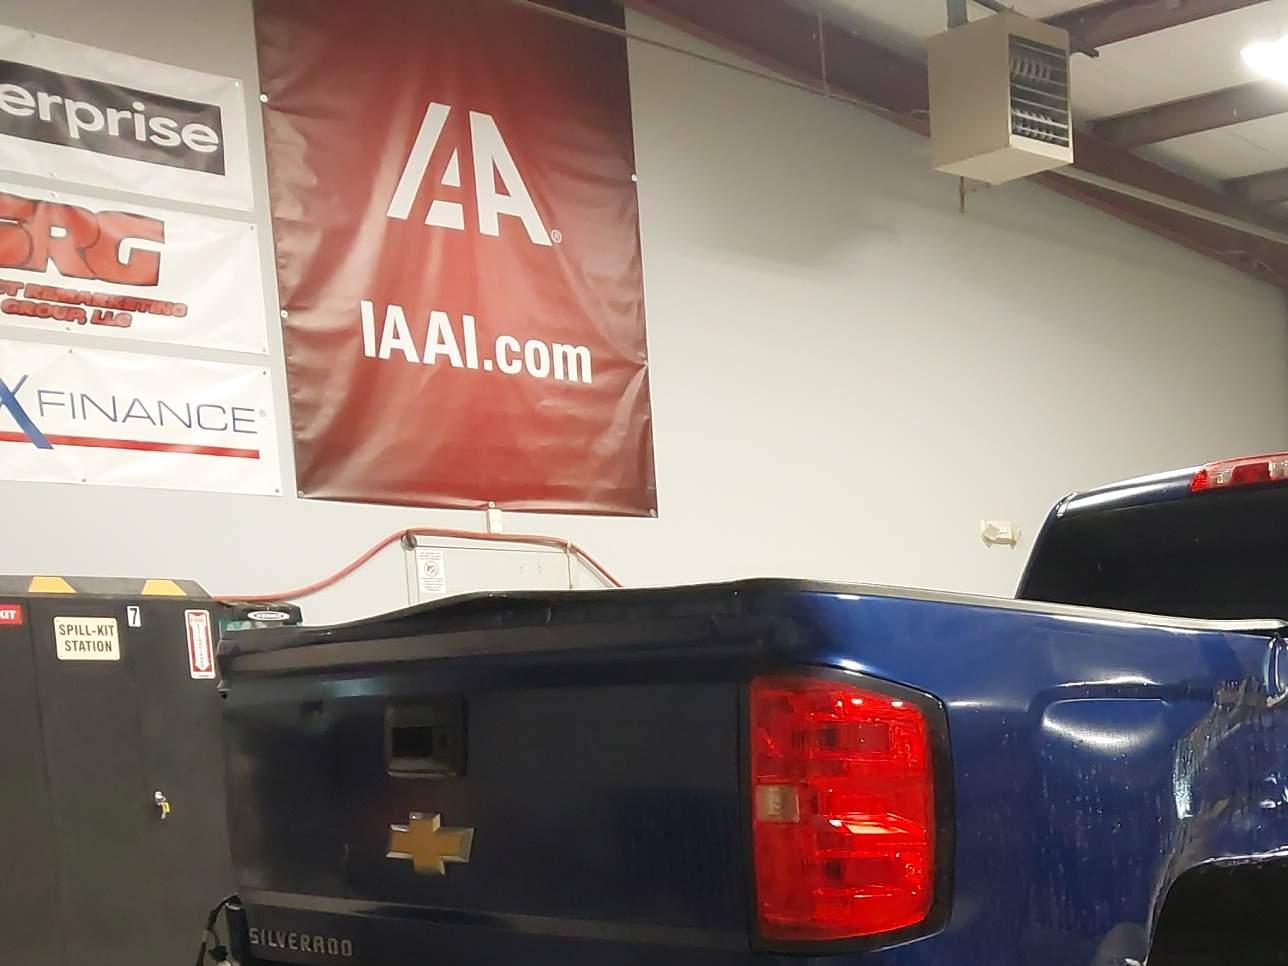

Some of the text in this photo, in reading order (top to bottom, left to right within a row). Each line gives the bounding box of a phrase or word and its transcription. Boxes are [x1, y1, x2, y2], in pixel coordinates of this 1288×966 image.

[0, 83, 219, 153] erprise
[386, 102, 553, 246] IAA
[360, 300, 593, 384] IAAI.com
[37, 389, 258, 435] FINANCE
[59, 623, 115, 637] SPILL-KIT
[129, 607, 138, 625] 7
[64, 639, 113, 652] STATION
[248, 927, 353, 957] SILVERADO
